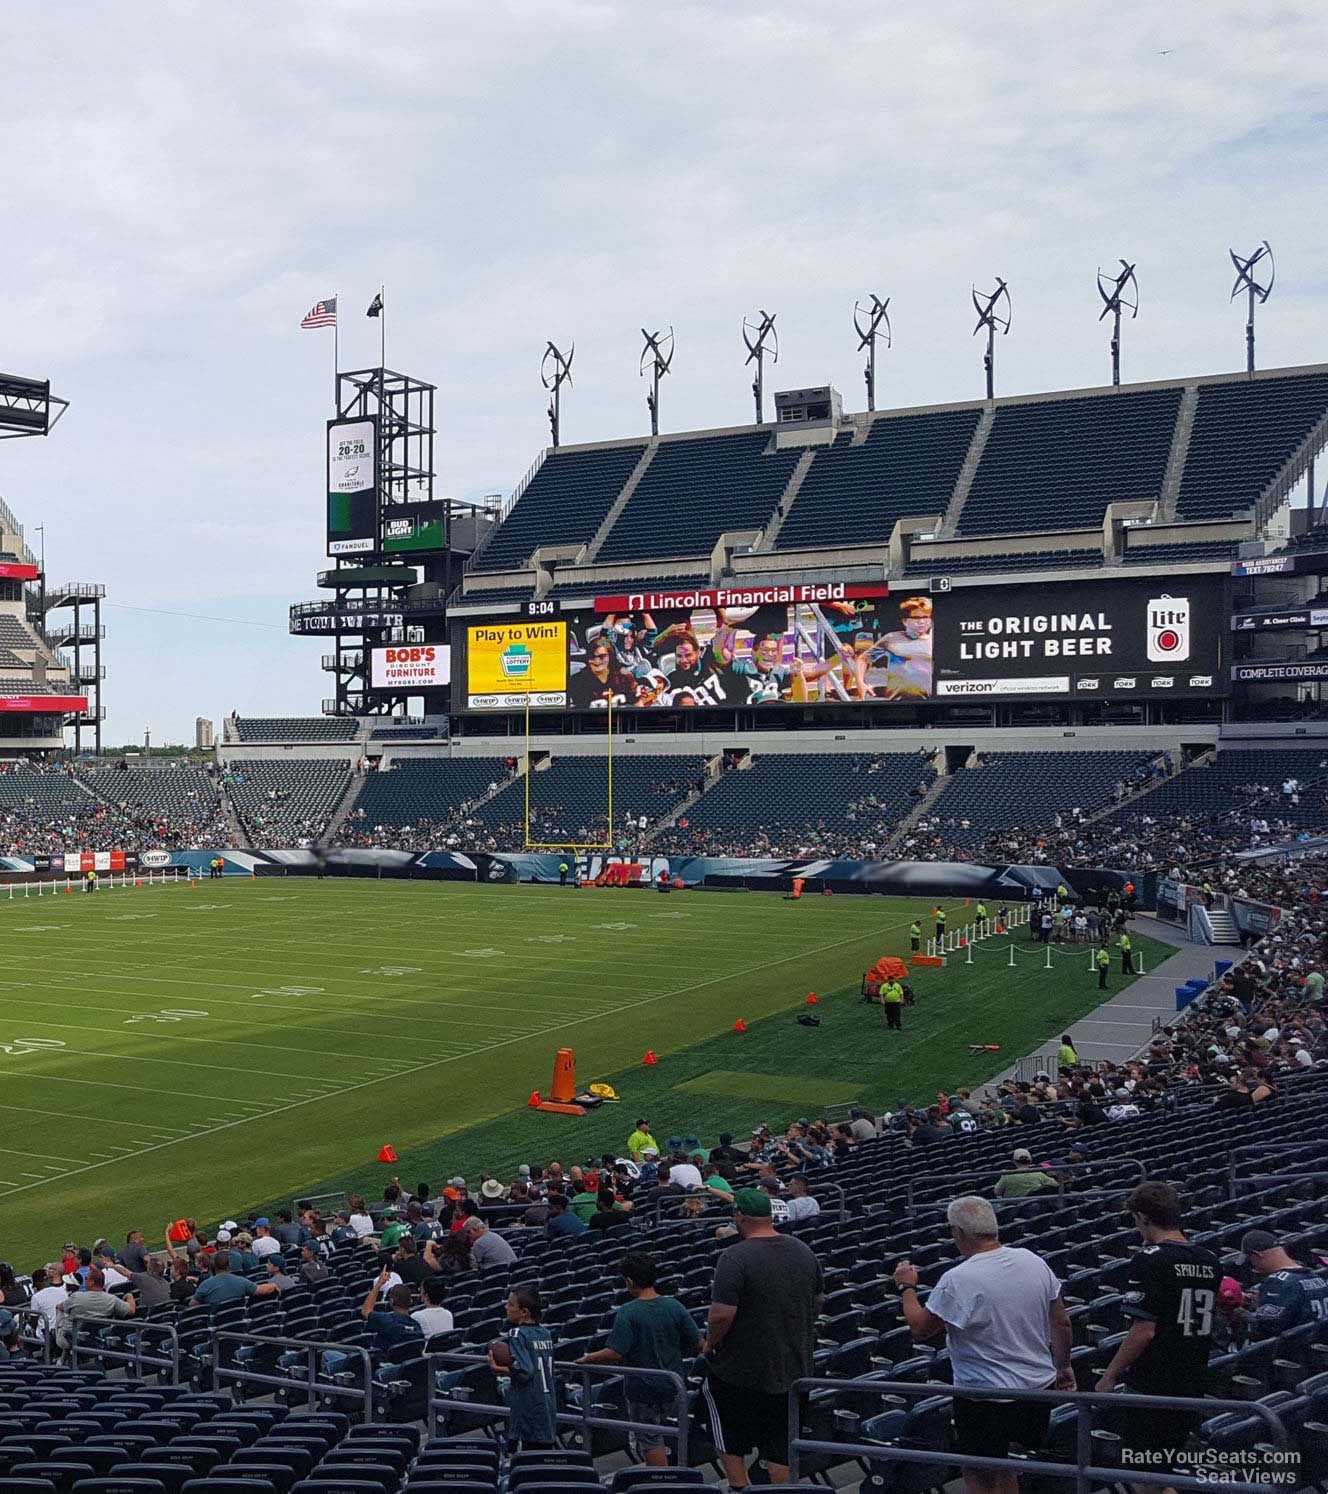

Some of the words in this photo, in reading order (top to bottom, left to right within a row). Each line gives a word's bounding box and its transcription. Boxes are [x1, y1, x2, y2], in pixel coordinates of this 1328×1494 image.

[339, 444, 365, 456] 20-20
[391, 520, 409, 529] BUD
[387, 527, 412, 536] LIGHT
[1246, 567, 1261, 575] TEXT
[650, 592, 712, 609] Lincoln
[716, 587, 795, 607] Financial
[801, 583, 845, 600] Field
[529, 602, 554, 614] 9:04
[960, 621, 983, 631] THE
[988, 613, 1112, 635] ORIGINAL
[1151, 609, 1186, 628] Lite
[476, 629, 505, 644] Play
[508, 629, 522, 640] to
[526, 626, 558, 639] Win!
[961, 640, 1034, 660] LIGHT
[1045, 637, 1112, 657] BEER
[386, 648, 436, 663] BOB'S
[386, 668, 436, 678] FURNITURE
[1240, 667, 1285, 679] COMPLETE
[946, 682, 993, 692] verizon
[1177, 1288, 1215, 1336] 43
